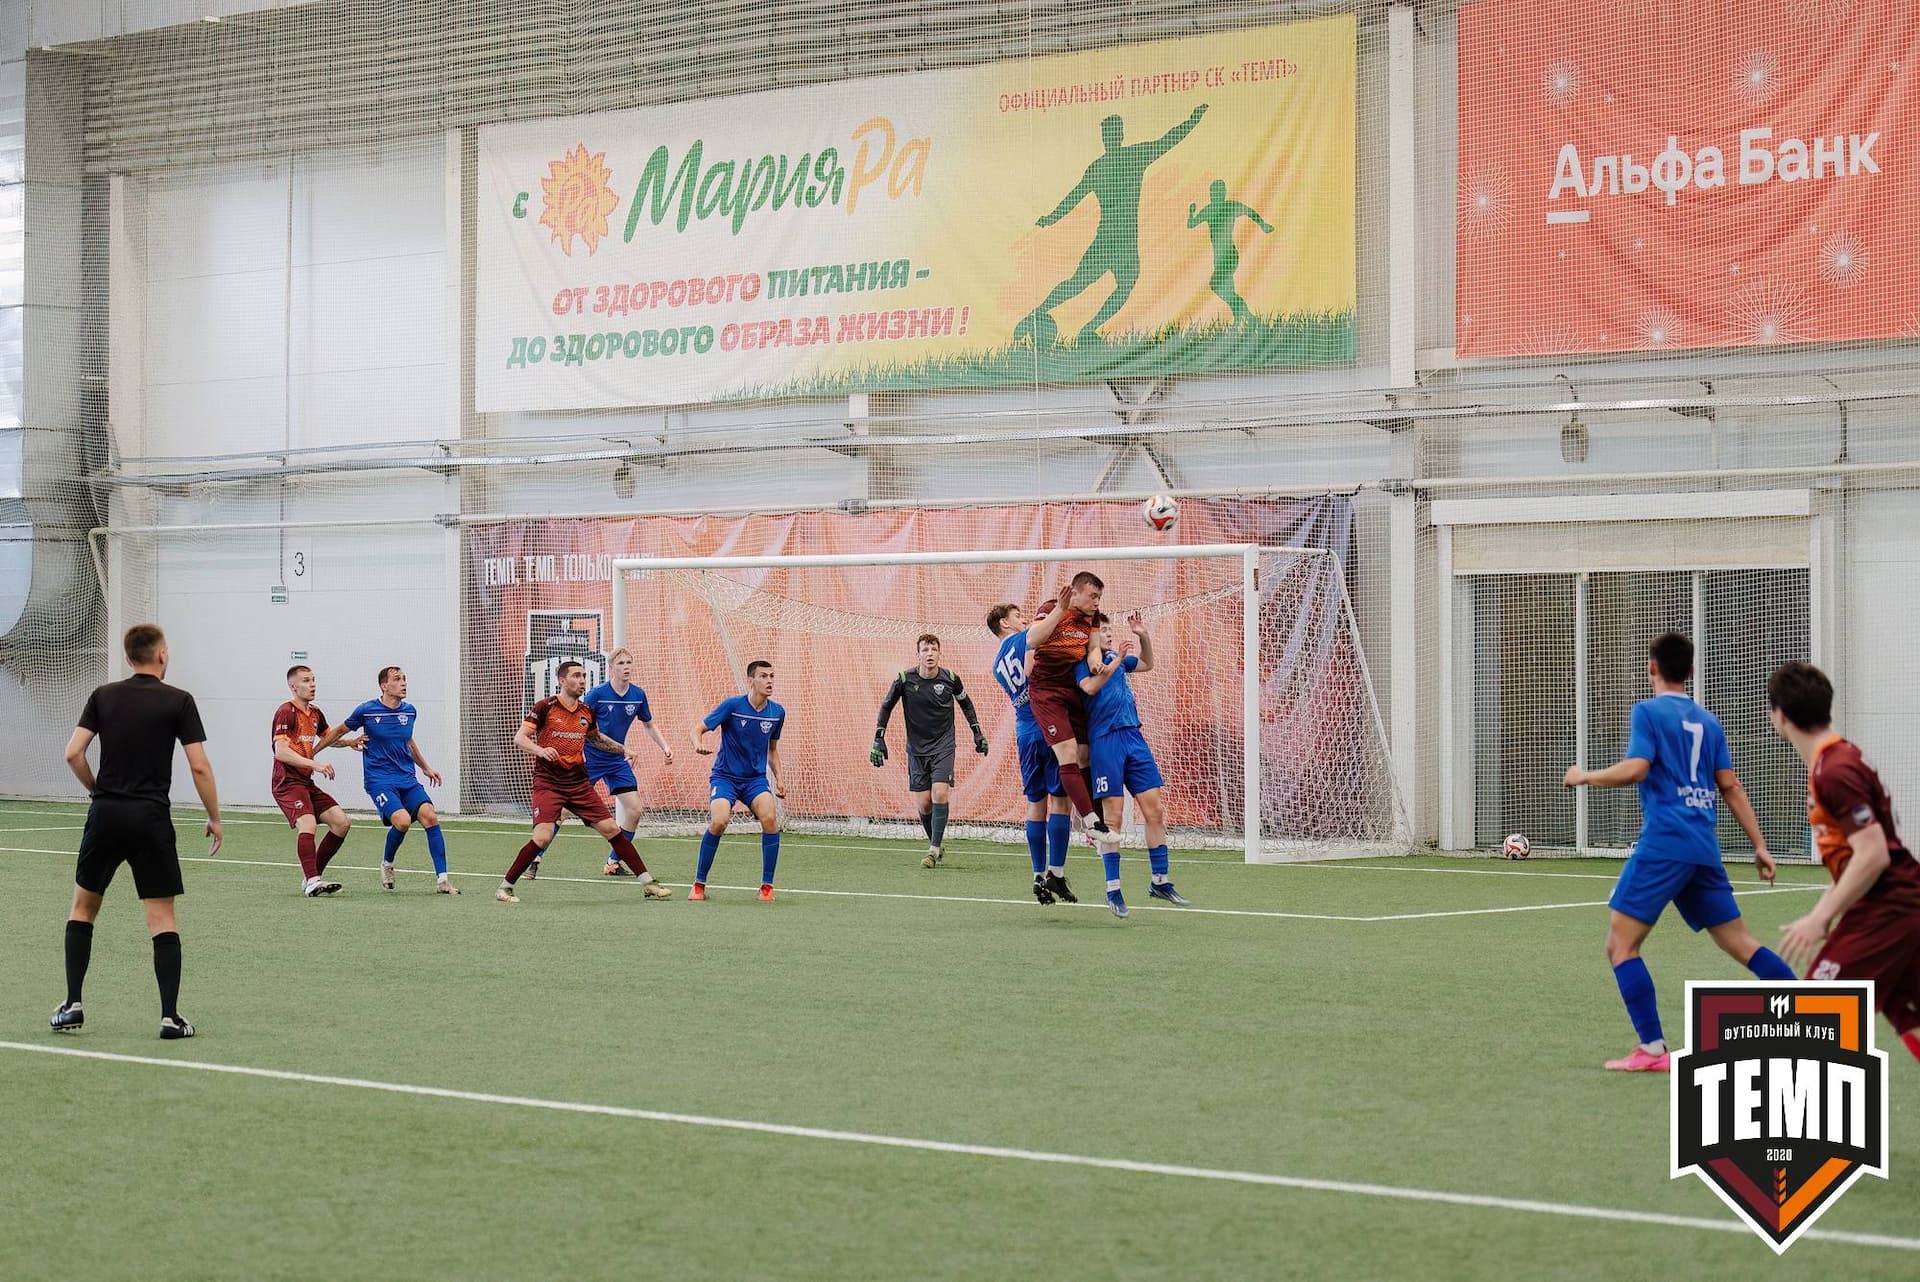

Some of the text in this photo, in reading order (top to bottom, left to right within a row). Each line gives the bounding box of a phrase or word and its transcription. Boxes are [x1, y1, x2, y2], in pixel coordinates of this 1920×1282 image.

[1000, 57, 1298, 113] ОФИЦИАЛЬНЫЙ ПАРТНЕР СК «ТЕМП»
[1547, 127, 1881, 206] Альфа Банк
[552, 286, 590, 315] ОТ
[592, 271, 761, 317] ЗДОРОВОГО
[767, 258, 911, 300] ПИТАНИЯ
[506, 335, 547, 370] ДО
[549, 324, 715, 368] ЗДОРОВОГО
[719, 315, 832, 352] ОБРАЗА
[294, 551, 305, 577] 3
[524, 554, 561, 584] ТЕМП,
[996, 645, 1026, 694] 15
[1682, 720, 1704, 783] 7
[376, 792, 389, 807] 21
[1095, 776, 1109, 793] 25
